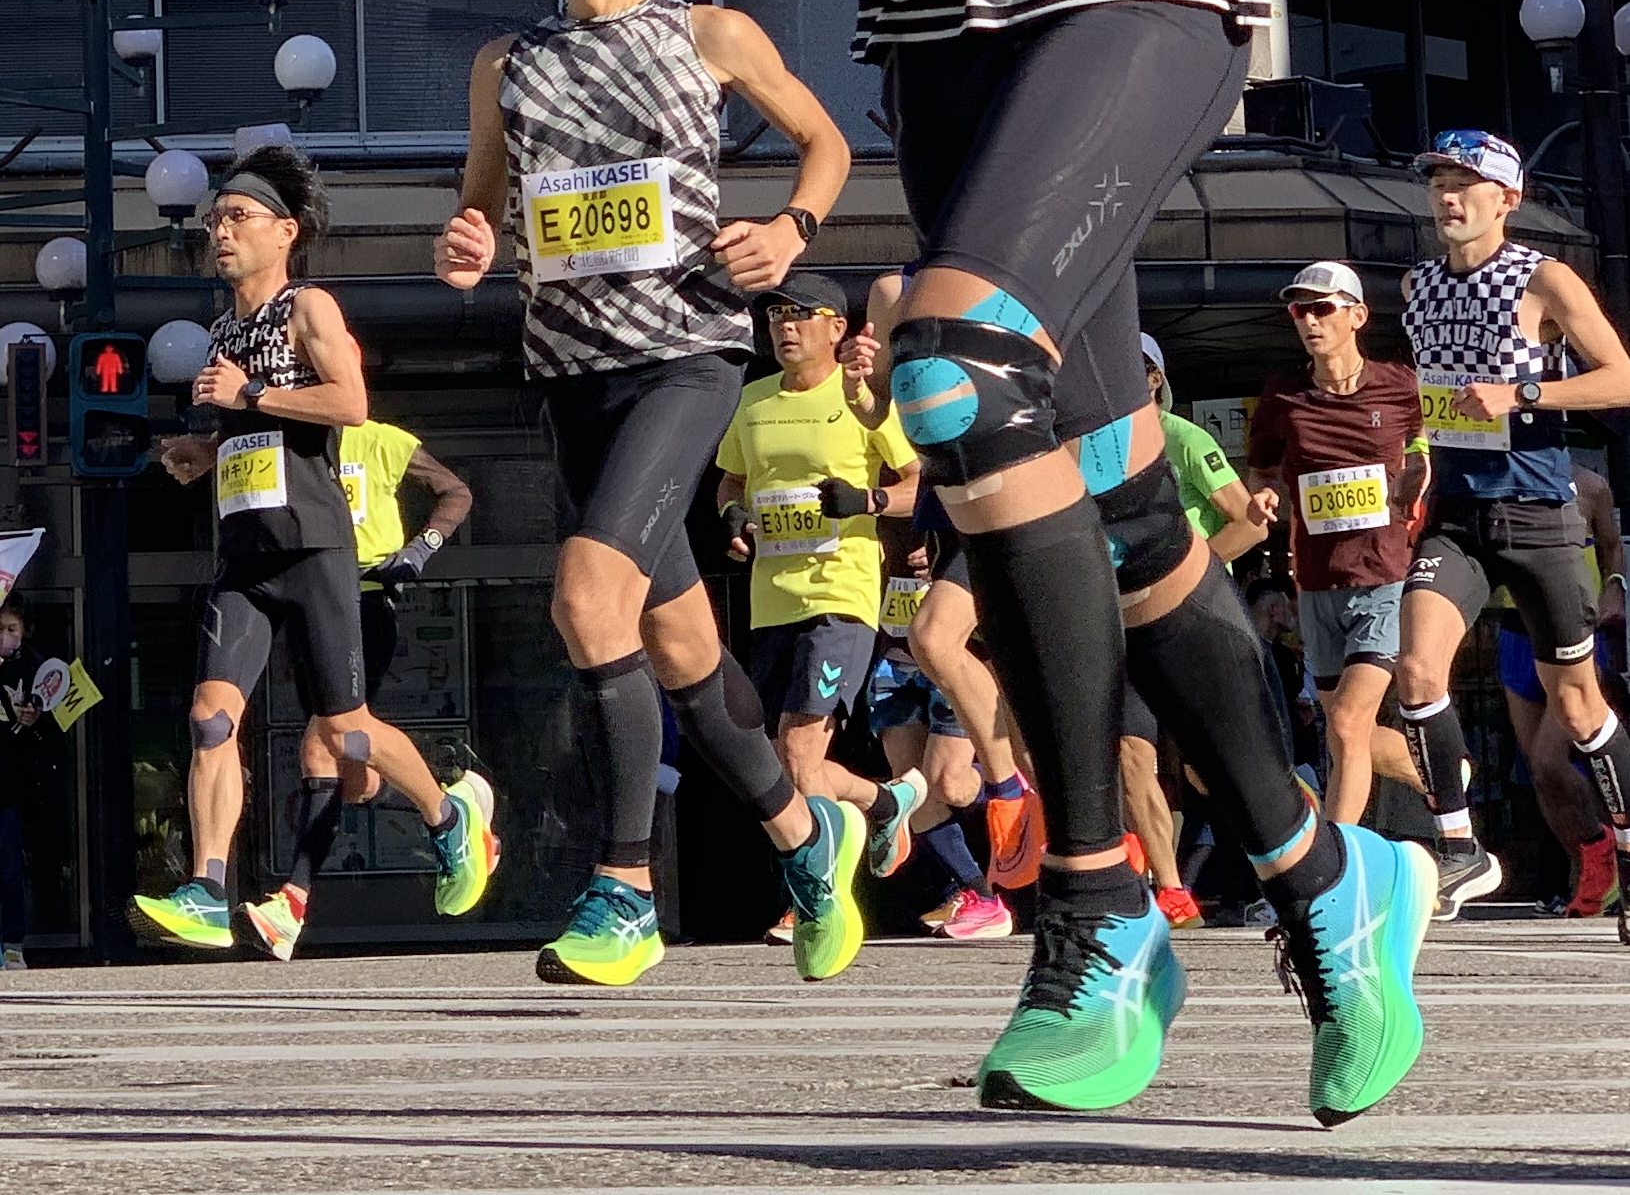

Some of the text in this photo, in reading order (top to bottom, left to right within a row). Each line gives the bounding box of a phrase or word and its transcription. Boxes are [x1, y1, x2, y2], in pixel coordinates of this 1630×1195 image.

[538, 162, 649, 194] AsahiKASEI
[540, 196, 651, 244] E20698
[1425, 299, 1483, 321] LALA
[1412, 324, 1500, 355] GAKUEN
[1309, 486, 1377, 514] D30605
[761, 509, 824, 534] E31367
